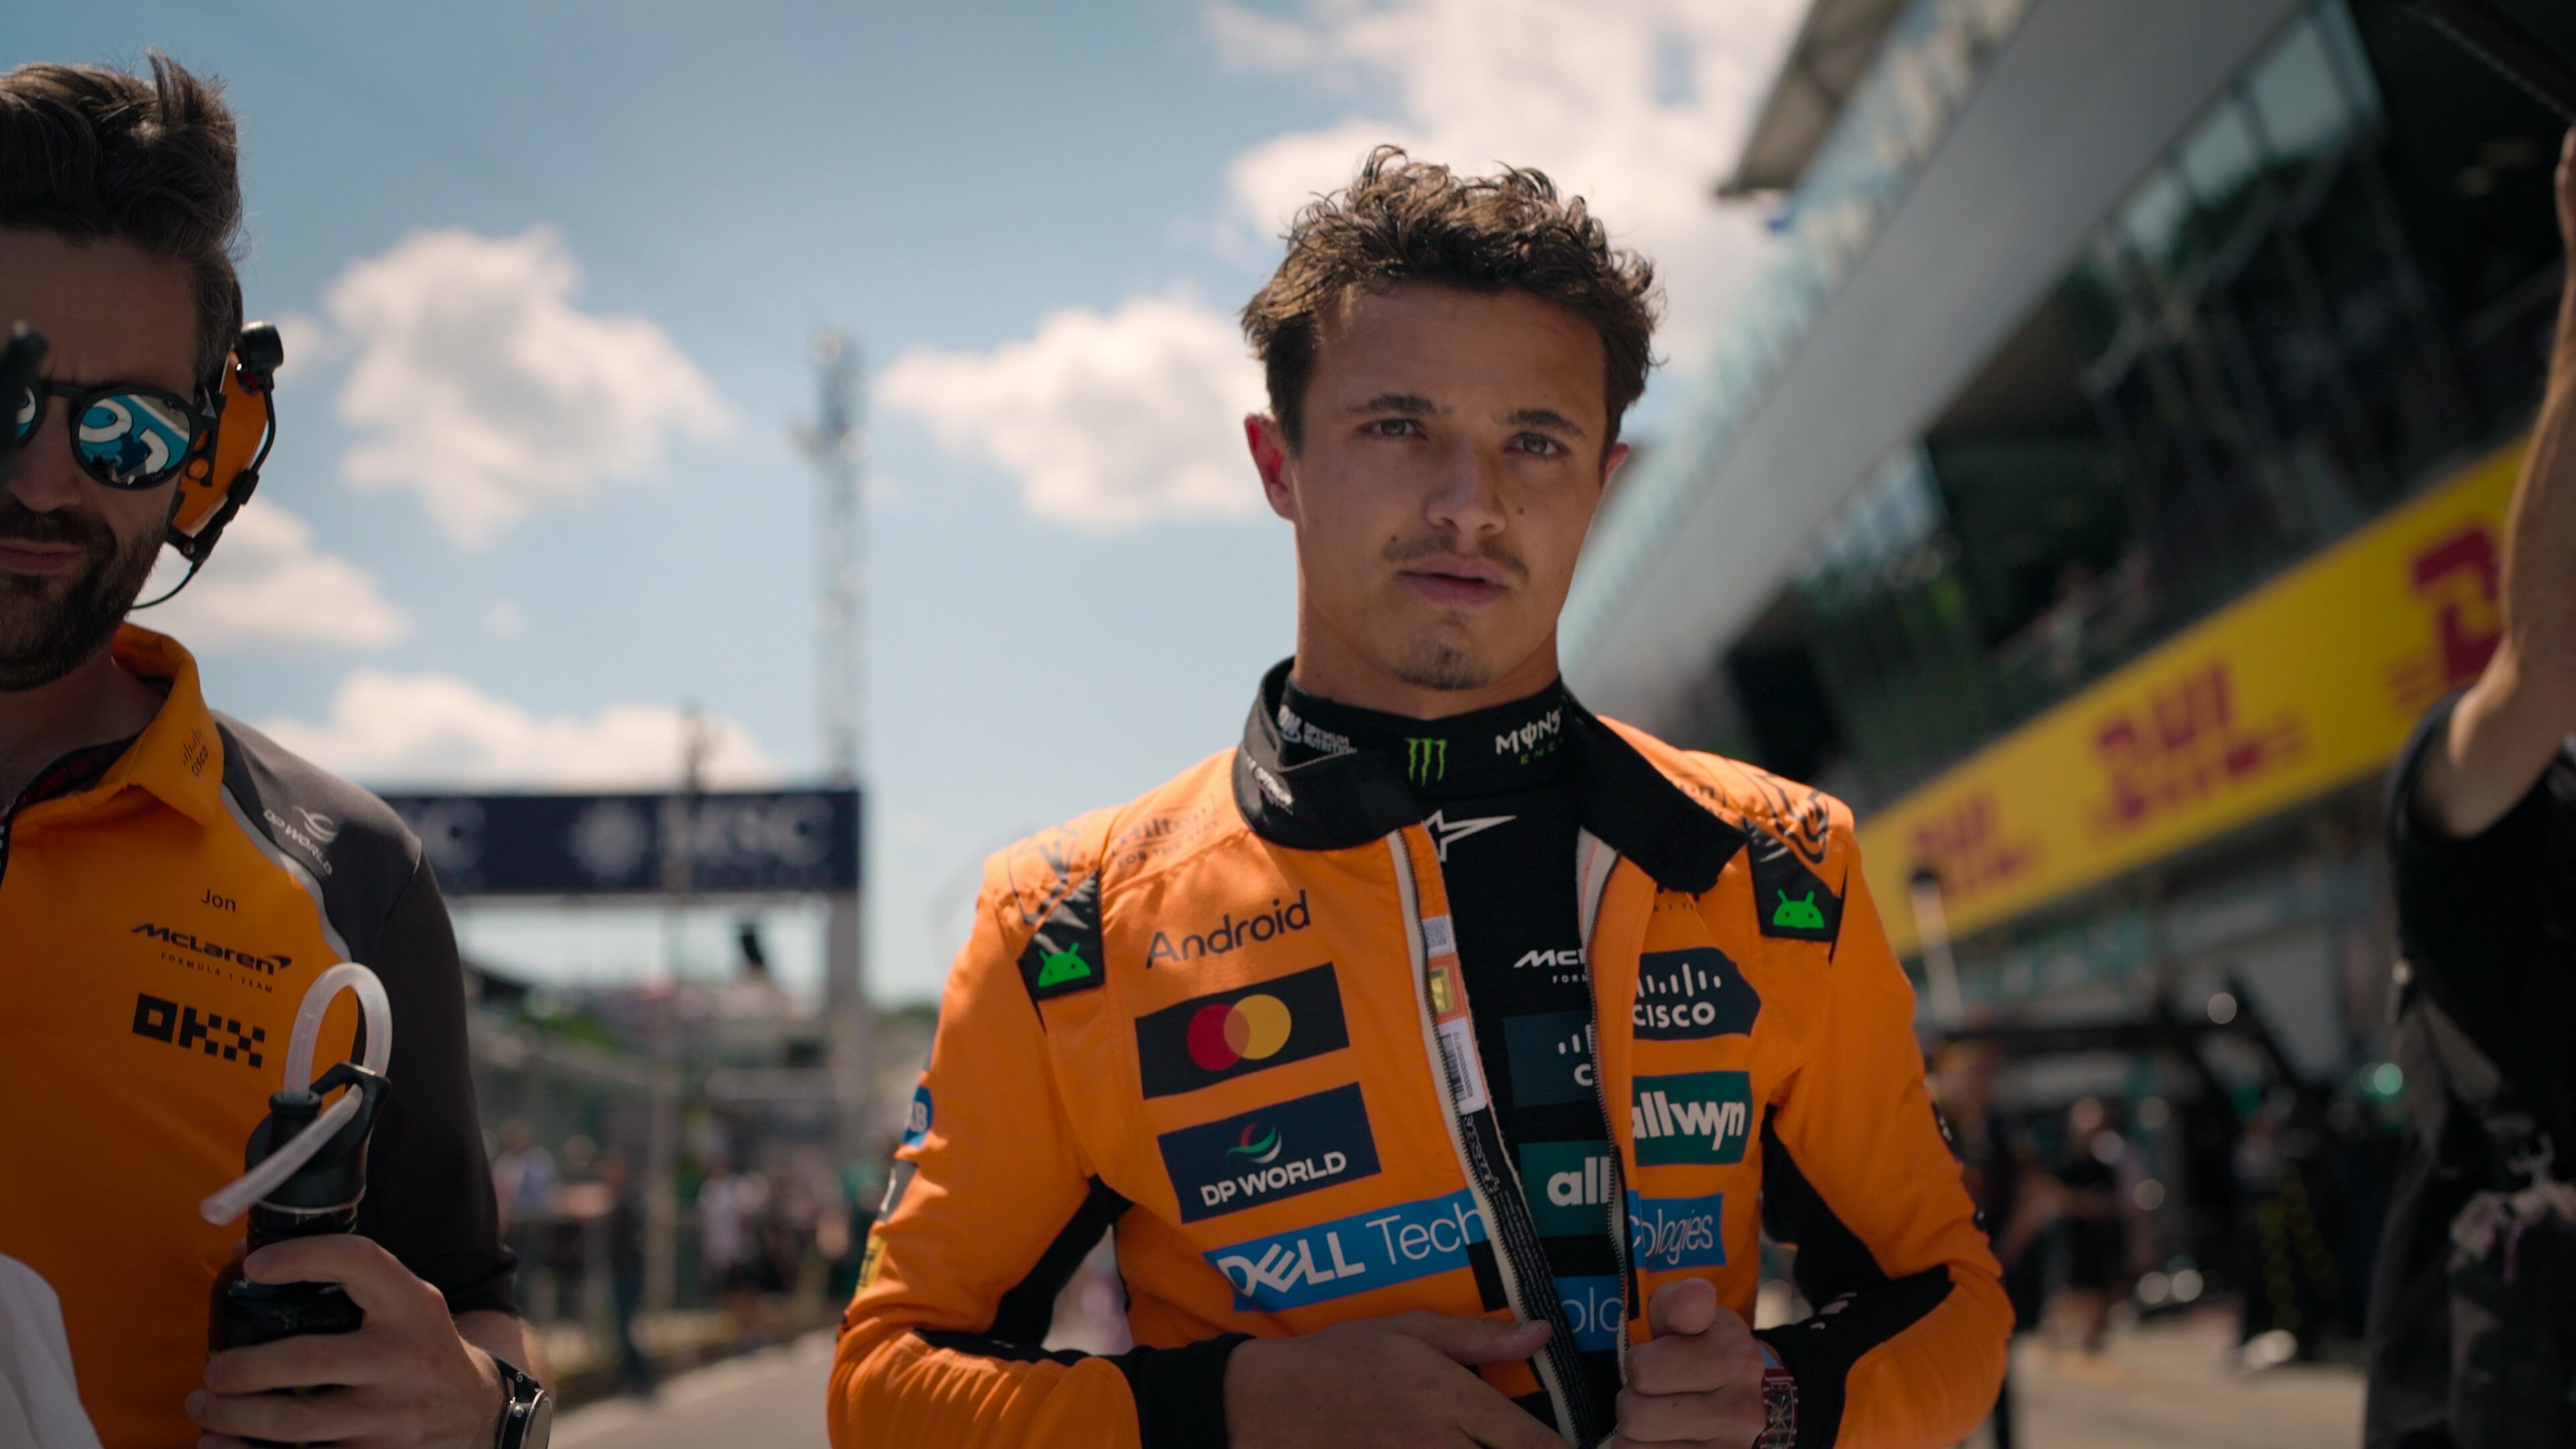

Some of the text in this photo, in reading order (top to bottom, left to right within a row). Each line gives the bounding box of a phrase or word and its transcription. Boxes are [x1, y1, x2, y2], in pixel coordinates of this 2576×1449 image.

[264, 809, 332, 875] DP WORLD
[201, 889, 237, 912] Jon
[1146, 889, 1311, 969] Android
[130, 923, 276, 975] McLaren
[161, 951, 220, 976] FORMULA
[241, 977, 272, 993] TEAM
[132, 992, 265, 1069] OKX
[1632, 1002, 1715, 1028] CISCO
[1200, 1150, 1347, 1207] DP WORLD
[1216, 1232, 1366, 1297] DELL
